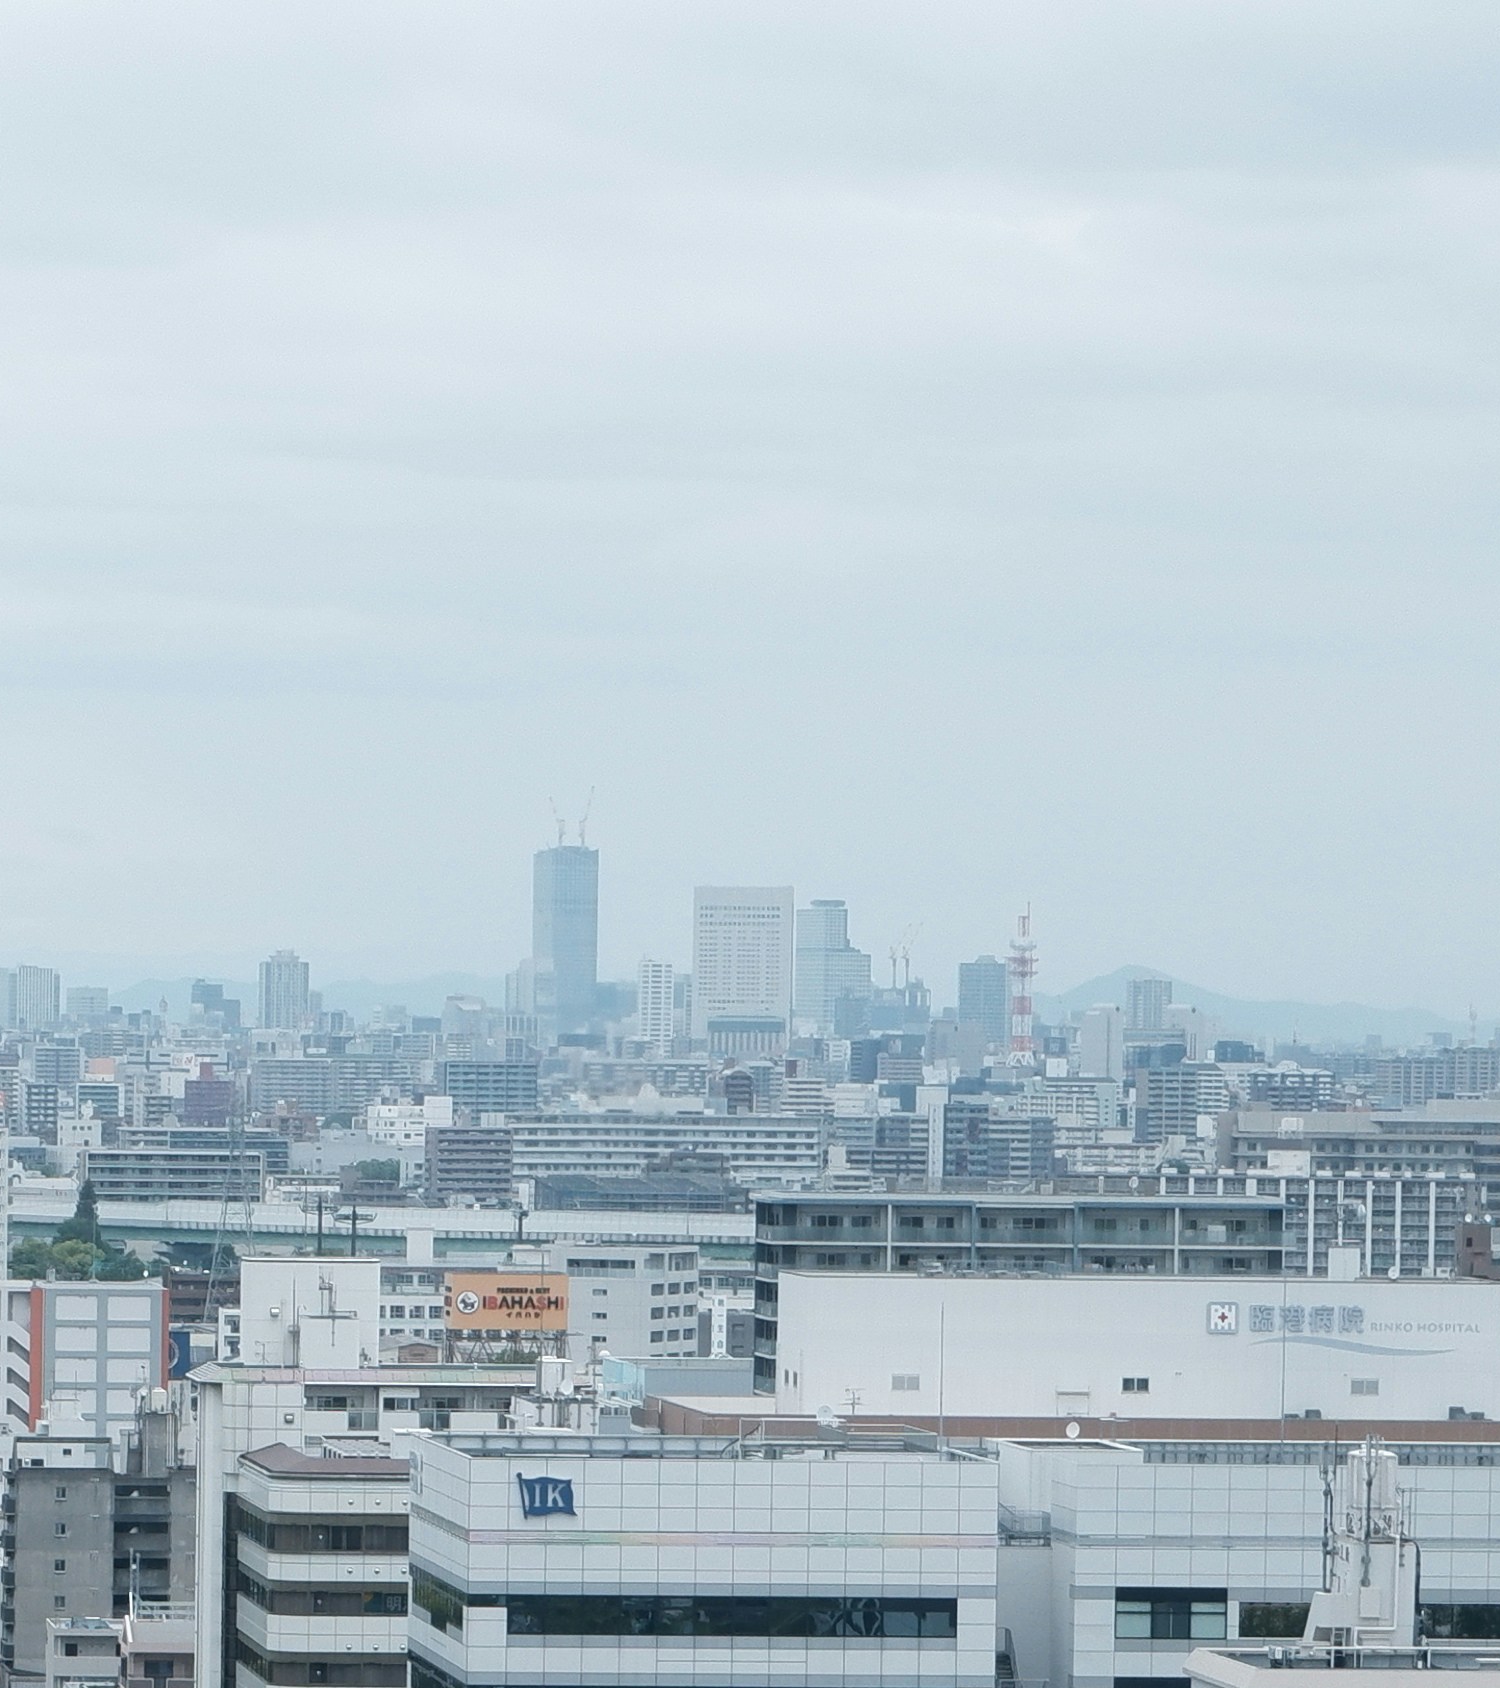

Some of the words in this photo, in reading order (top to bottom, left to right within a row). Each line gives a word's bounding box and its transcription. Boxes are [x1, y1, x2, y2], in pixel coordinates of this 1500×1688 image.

[482, 1295, 565, 1311] IBAHASHI
[1249, 1304, 1365, 1333] 臨港病院
[1370, 1322, 1413, 1333] RINKO
[1416, 1322, 1481, 1333] HOSPITAL
[533, 1482, 567, 1508] IK
